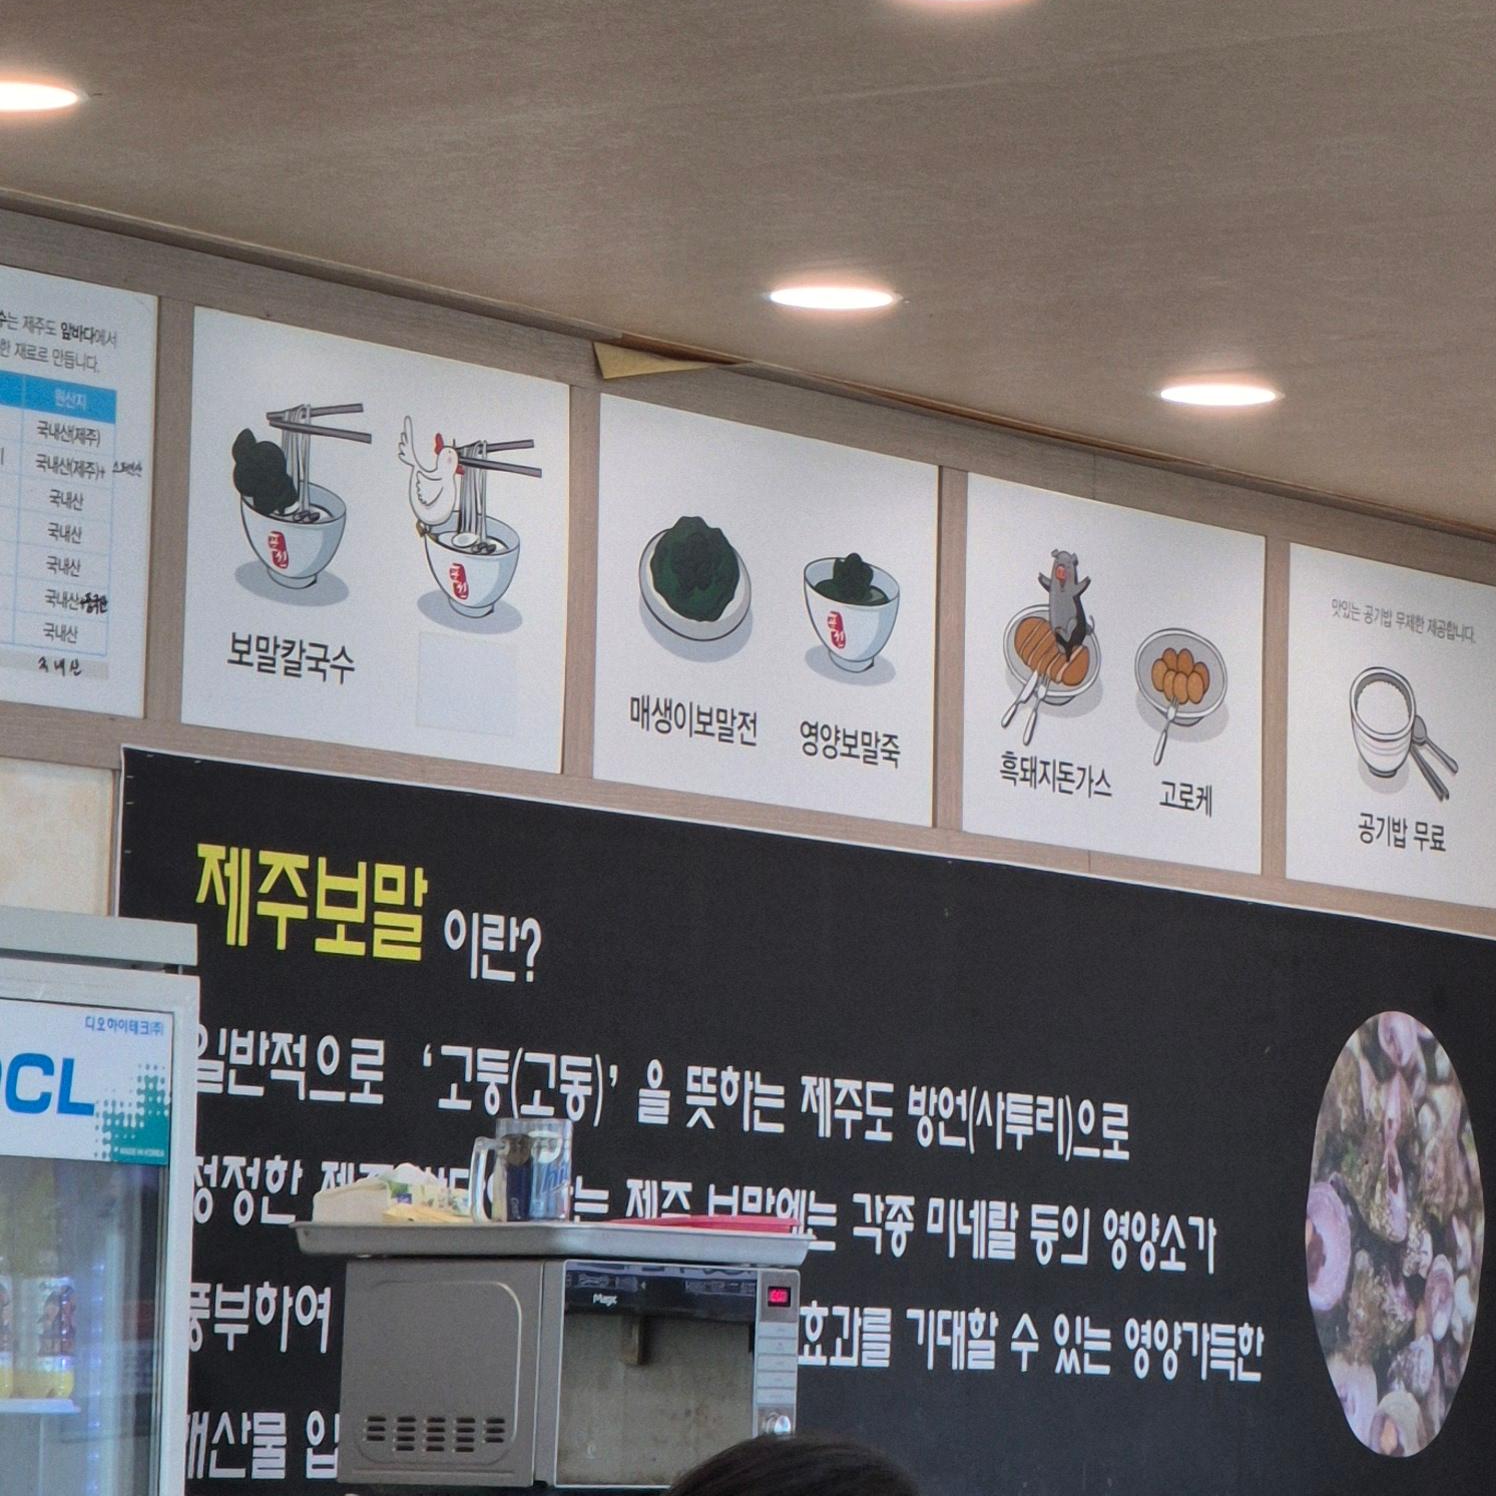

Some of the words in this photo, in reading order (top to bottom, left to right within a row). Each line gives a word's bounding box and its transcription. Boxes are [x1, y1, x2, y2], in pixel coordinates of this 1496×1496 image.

[22, 315, 58, 337] 제주도
[60, 321, 118, 349] 앞바다에서
[14, 342, 49, 363] 재료로
[52, 349, 100, 373] 만듭니다.
[37, 420, 101, 448] 국내산(제주)
[49, 489, 84, 511] 국내산
[47, 522, 82, 544] 국내산
[46, 556, 81, 577] 국내산
[43, 622, 78, 644] 국내산
[1331, 598, 1361, 622] 맛있는
[1363, 604, 1393, 628] 공기밥
[1395, 611, 1425, 634] 무제한
[227, 632, 356, 685] 보말칼국수
[629, 694, 758, 747] 매생이보말전
[800, 720, 901, 768] 영양보말죽
[999, 750, 1112, 799] 흑돼지돈가스
[1158, 780, 1213, 818] 고로케
[1358, 812, 1407, 849] 공기밥
[1413, 821, 1447, 853] 무료
[196, 843, 428, 961] 제주보말
[444, 908, 543, 983] 이란?
[0, 1052, 95, 1117] CL
[197, 1024, 385, 1104] 일반적으로
[638, 1059, 671, 1124] 을
[686, 1065, 785, 1133] 뜻하는
[801, 1075, 894, 1141] 제주도
[908, 1084, 1130, 1161] 방언(사투리)으로
[852, 1193, 915, 1257] 각종
[926, 1197, 1018, 1260] 미네랄
[1030, 1204, 1090, 1265] 등의
[1103, 1208, 1216, 1275] 영양소가
[798, 1300, 892, 1367] 효과를
[906, 1307, 999, 1371] 기대할
[1010, 1313, 1039, 1372] 수
[1053, 1313, 1112, 1375] 있는
[1124, 1317, 1264, 1382] 영양가득한
